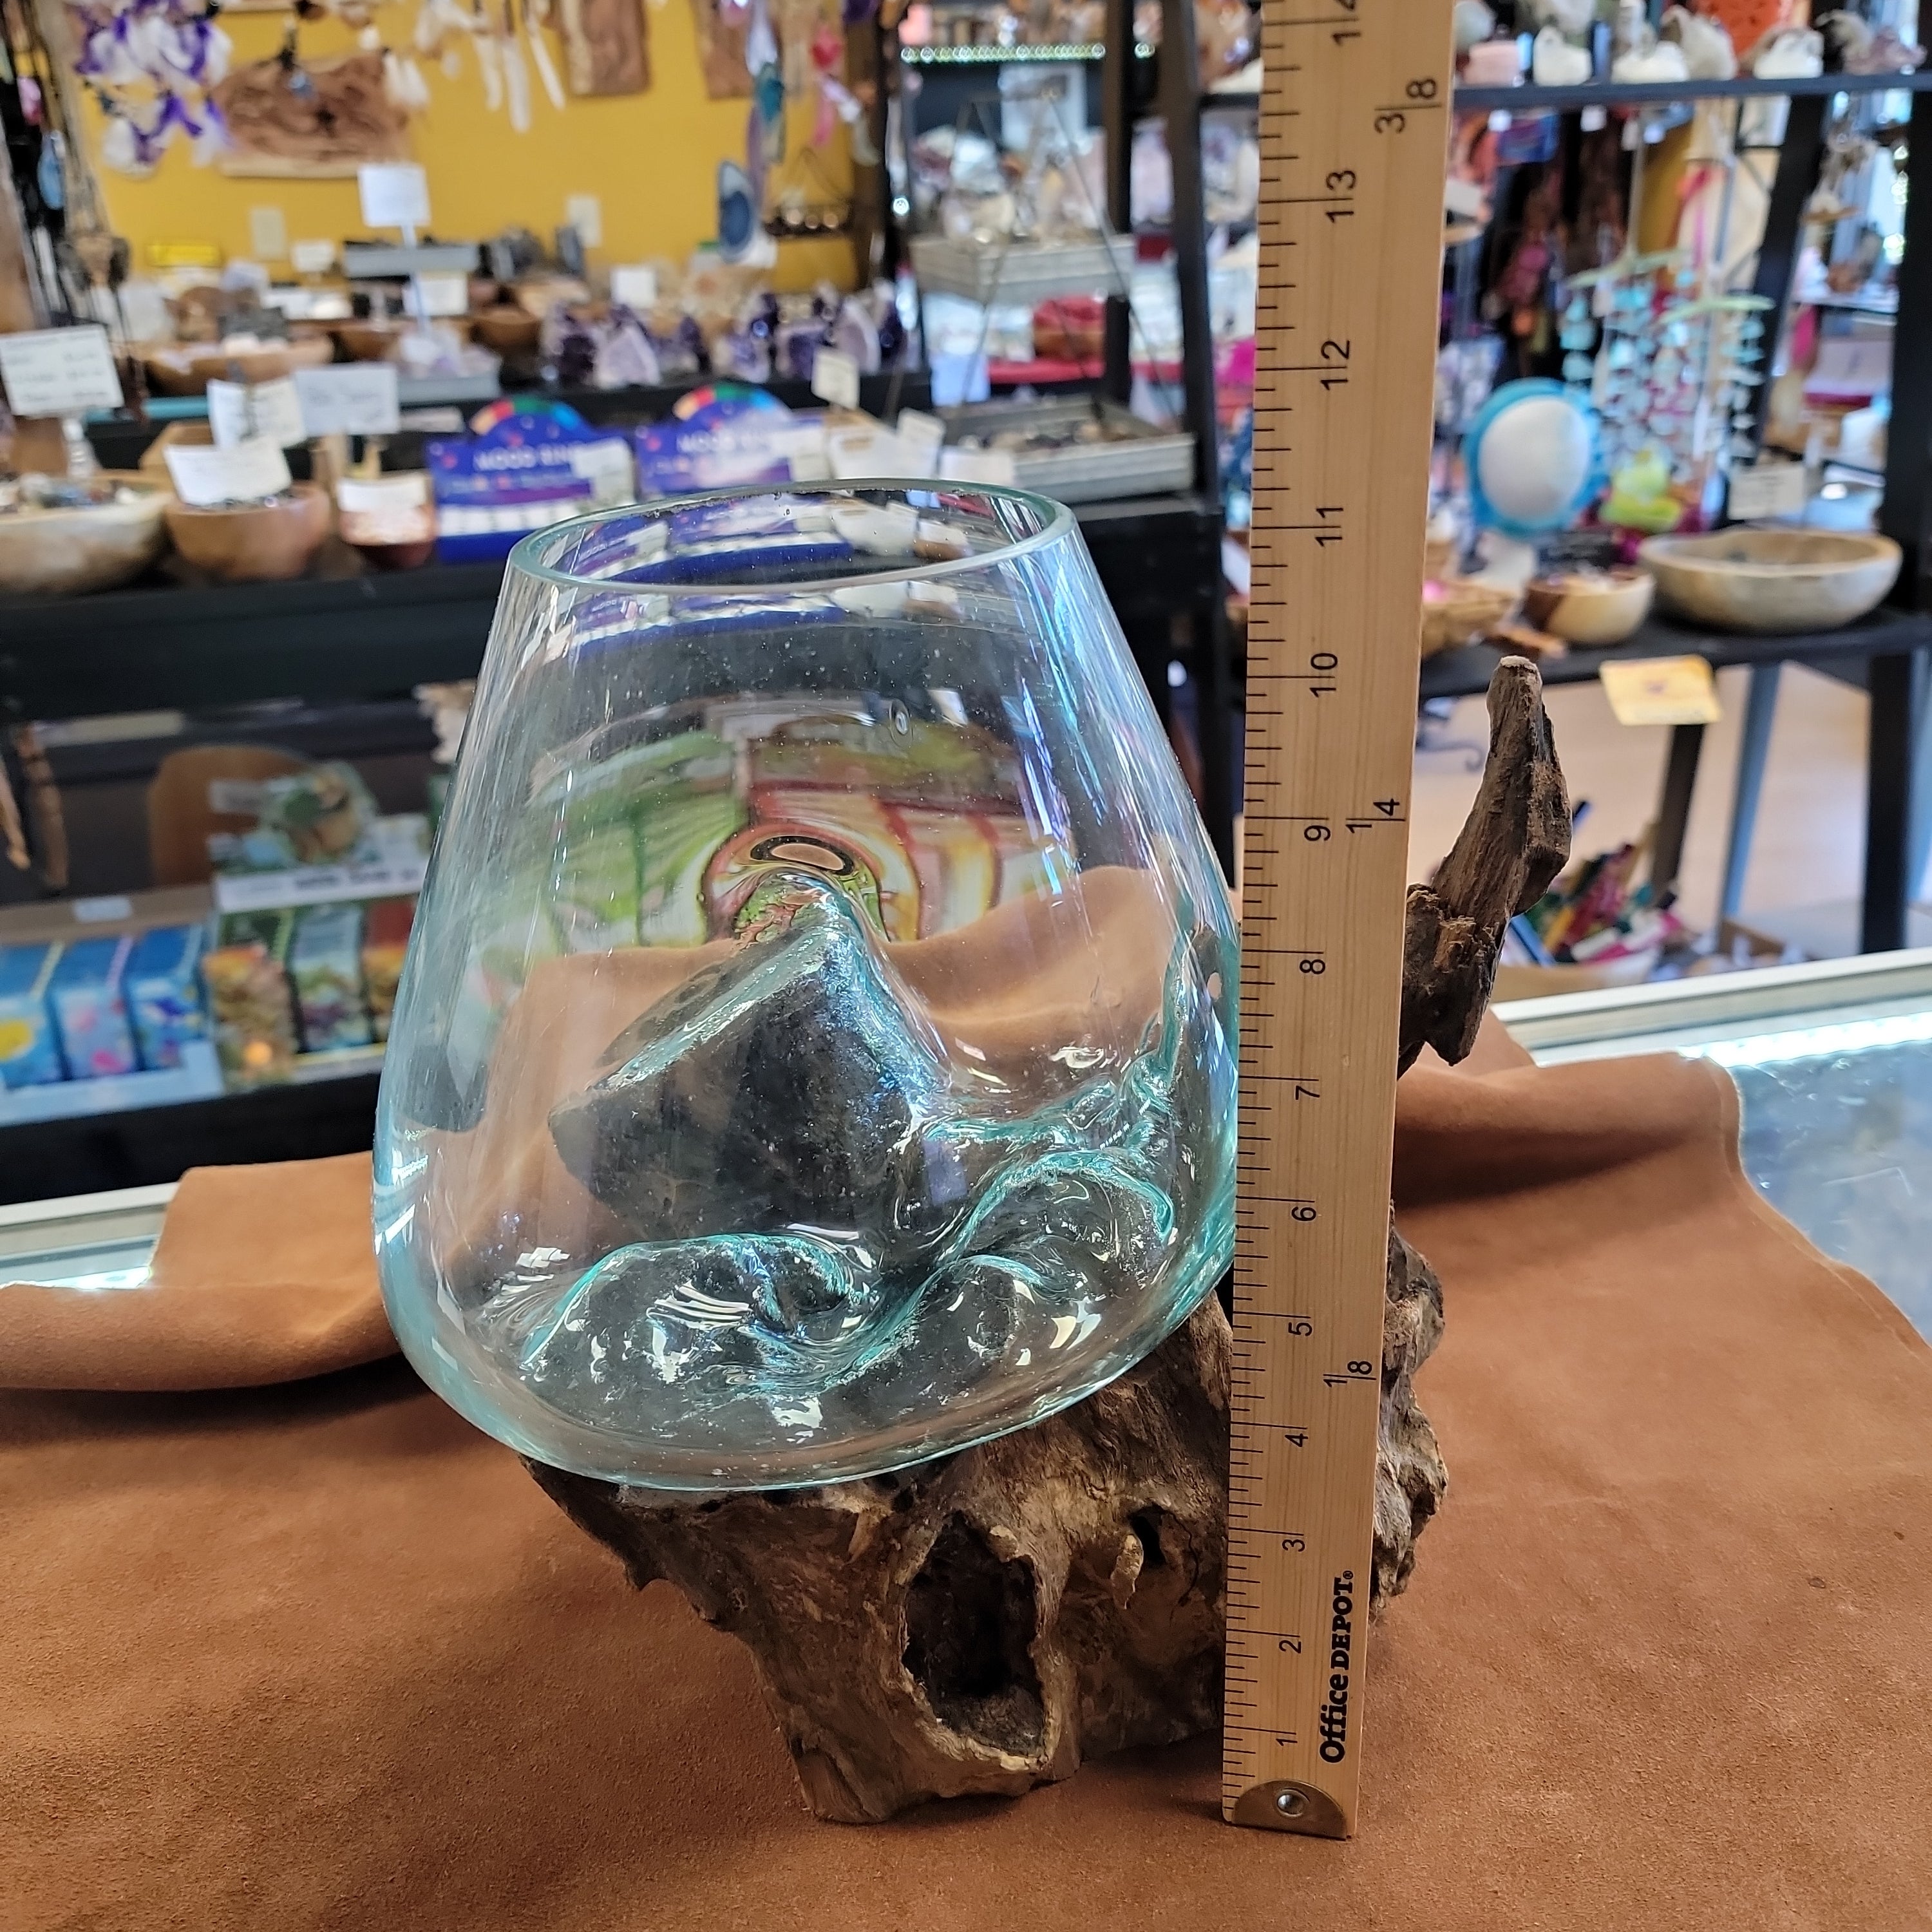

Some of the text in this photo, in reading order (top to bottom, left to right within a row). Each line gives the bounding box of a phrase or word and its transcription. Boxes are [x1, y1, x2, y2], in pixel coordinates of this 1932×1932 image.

[1326, 169, 1357, 223] 13
[1320, 339, 1350, 391] 12
[1316, 506, 1344, 547] 11
[1309, 652, 1338, 698] 10
[1303, 824, 1331, 842] 9
[1299, 958, 1326, 975] 8
[1295, 1085, 1320, 1101] 7
[1291, 1206, 1317, 1222] 6
[1288, 1321, 1313, 1337] 5
[1285, 1433, 1309, 1448] 4
[1282, 1538, 1306, 1553] 3
[1278, 1639, 1302, 1654] 2
[1319, 1674, 1349, 1763] Office
[1275, 1738, 1298, 1747] 1
